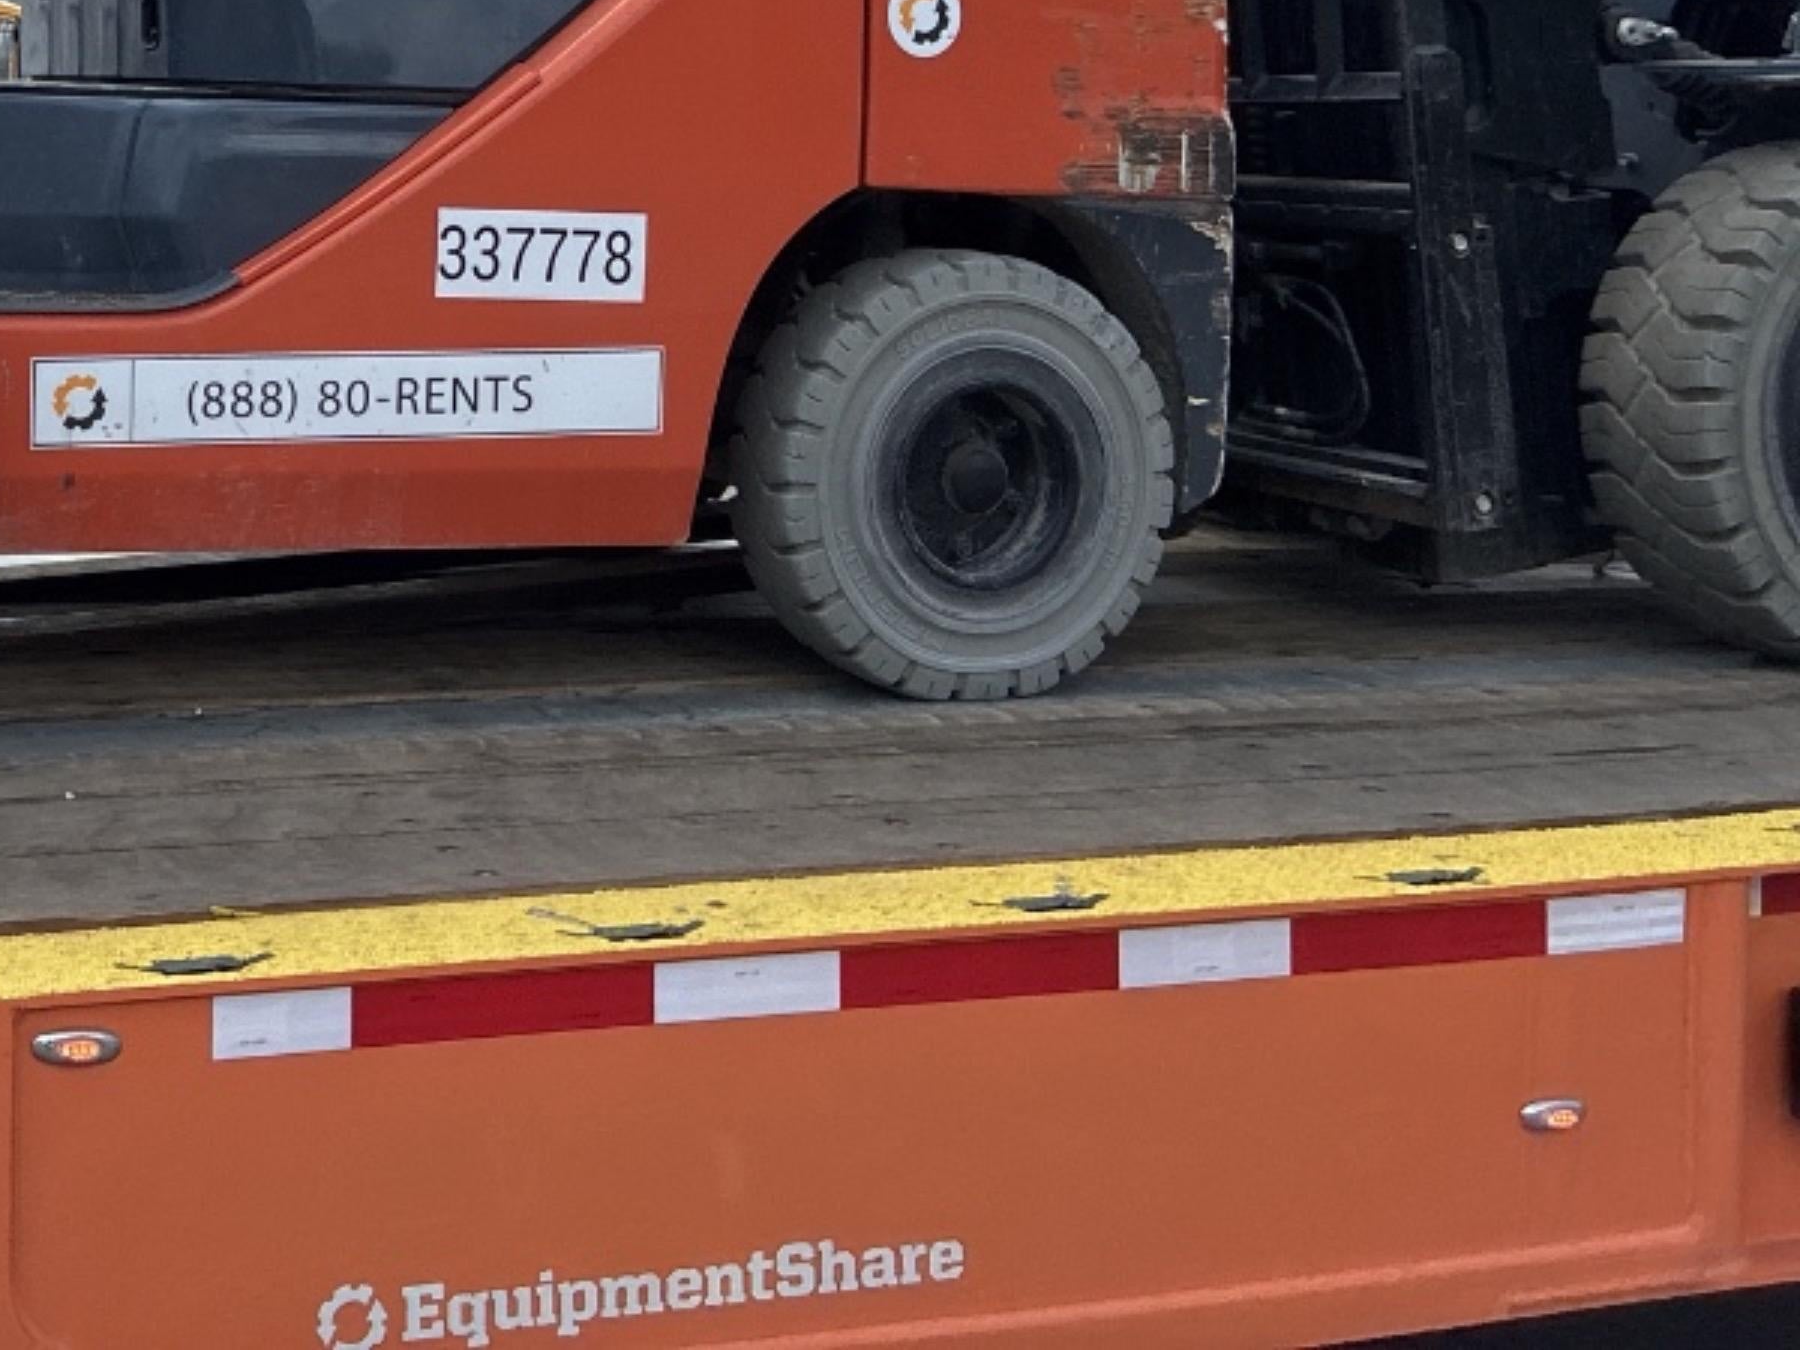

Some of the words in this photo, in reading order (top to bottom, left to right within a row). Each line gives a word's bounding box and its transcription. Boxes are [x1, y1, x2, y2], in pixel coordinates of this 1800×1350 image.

[437, 223, 633, 284] 337778
[186, 378, 298, 425] (888)
[316, 374, 534, 418] 80-RENTS
[401, 1237, 965, 1348] EquipmentShare
